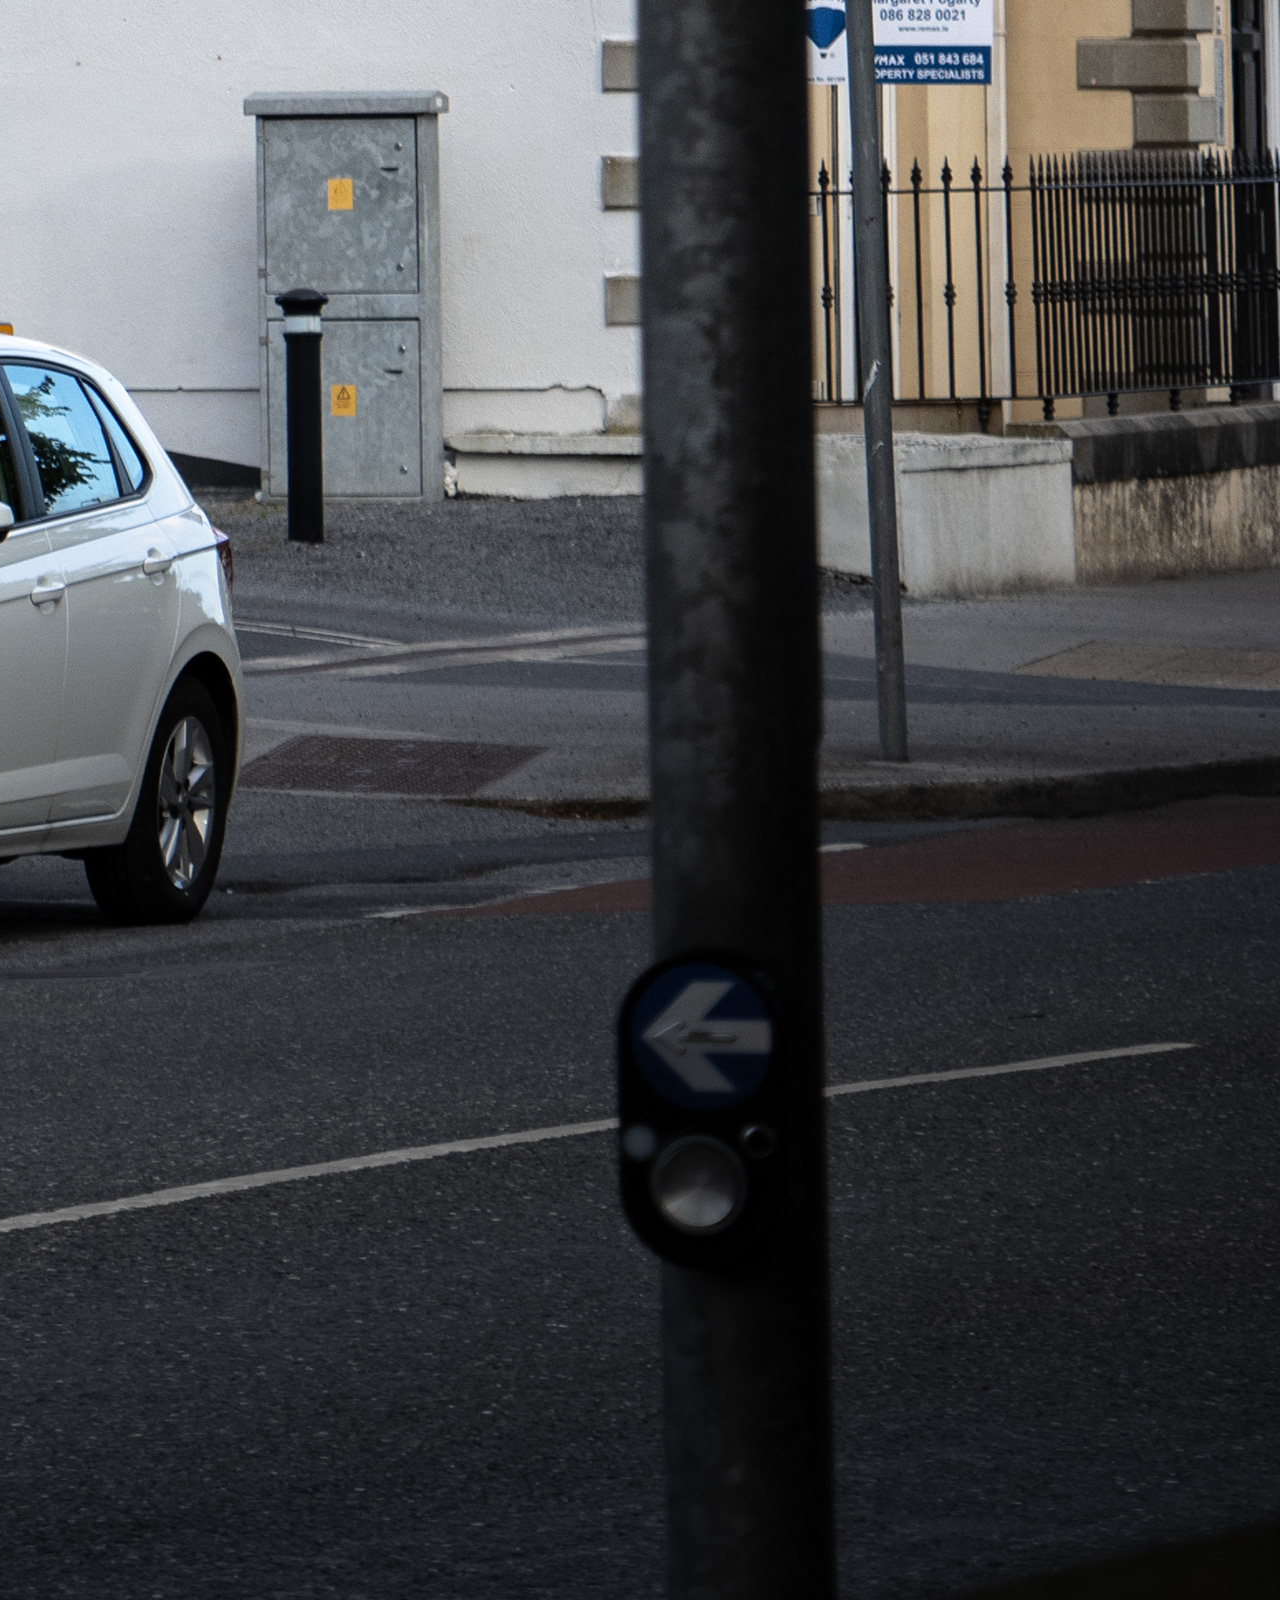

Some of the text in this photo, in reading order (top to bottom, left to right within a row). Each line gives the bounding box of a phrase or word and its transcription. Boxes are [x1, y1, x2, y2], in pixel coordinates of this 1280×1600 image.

[880, 9, 966, 21] 086 828 0021
[874, 52, 984, 66] /MAX 051 843 684
[875, 68, 985, 80] OPERTY SPECIALISTS
